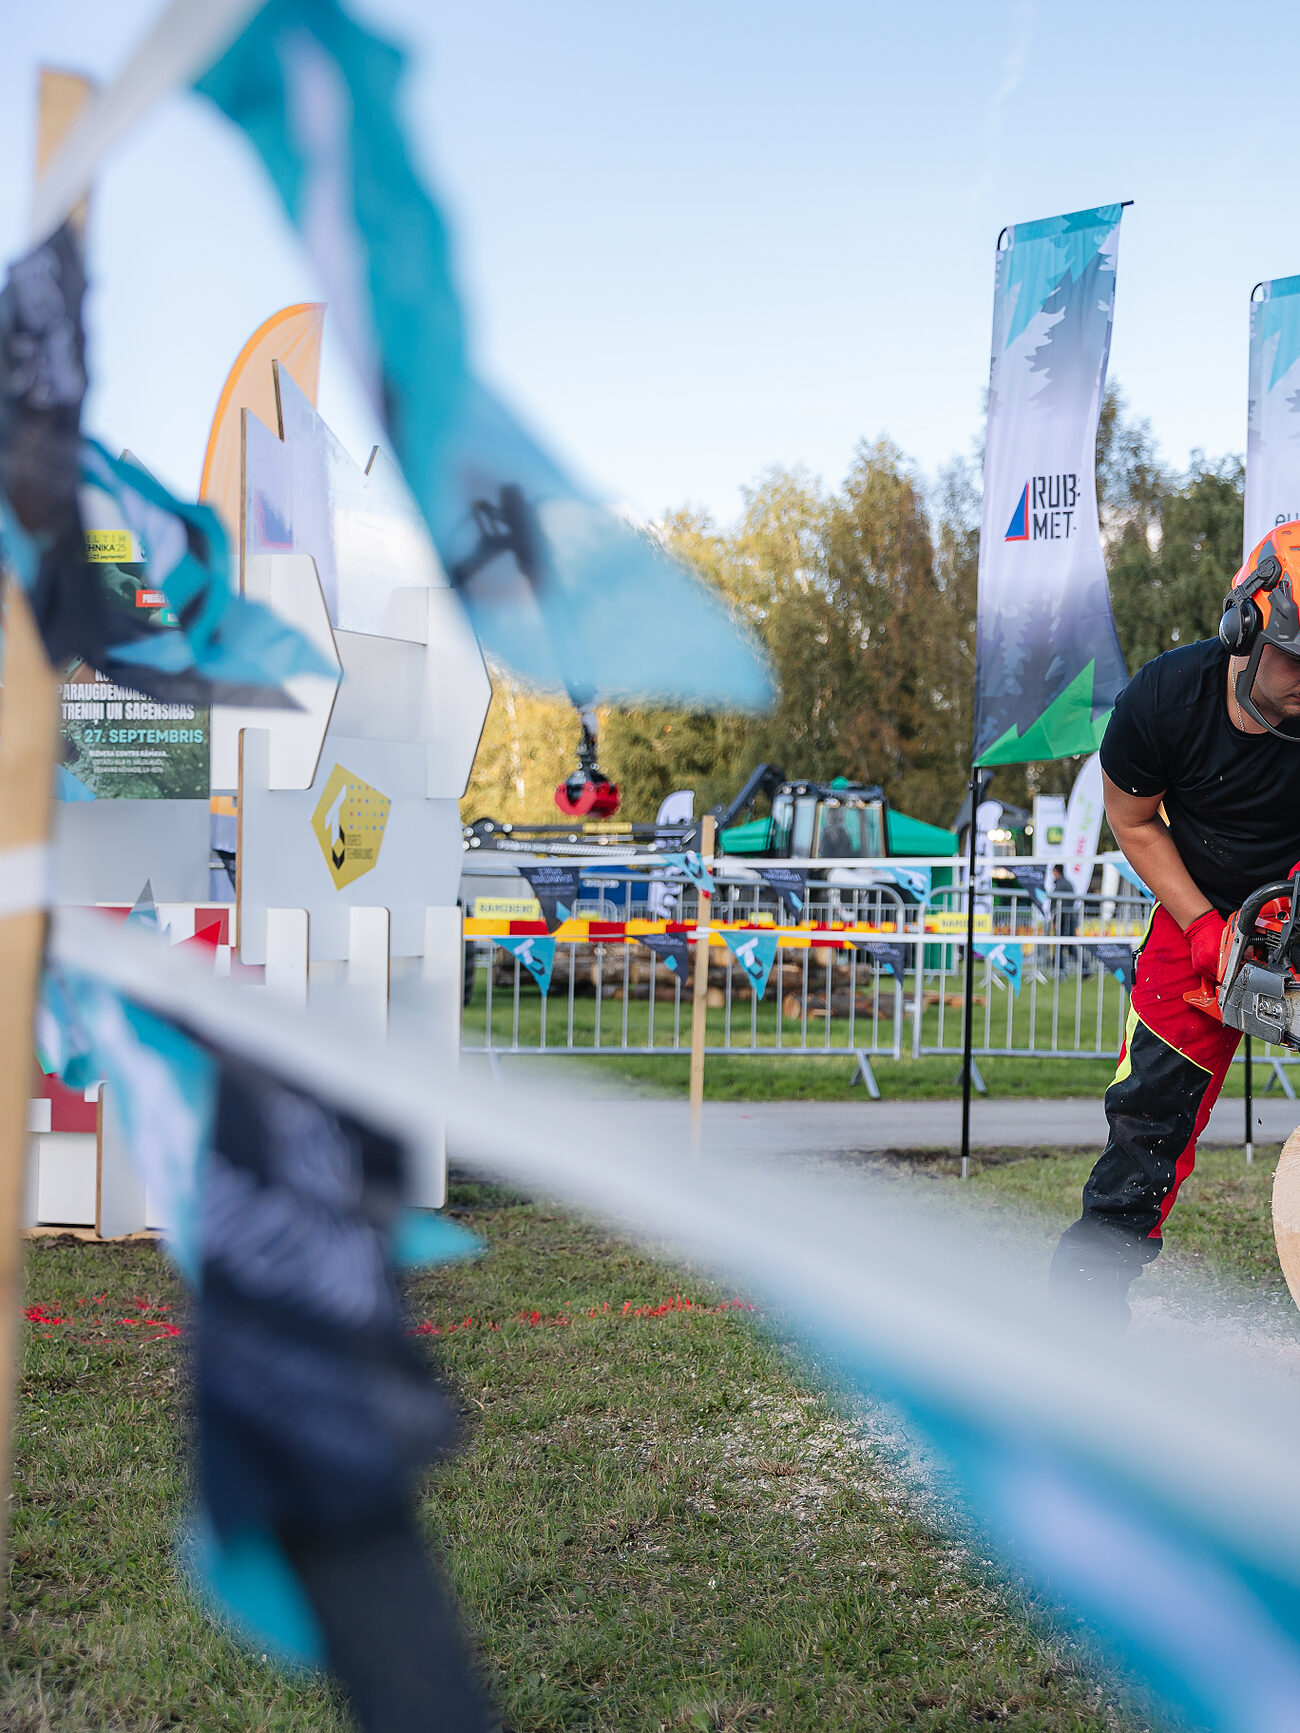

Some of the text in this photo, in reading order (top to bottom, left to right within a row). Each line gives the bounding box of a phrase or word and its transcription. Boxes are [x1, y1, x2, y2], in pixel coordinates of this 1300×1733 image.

[106, 702, 123, 720] UN
[84, 728, 107, 744] 27.
[108, 728, 204, 744] SEPTEMBRIS
